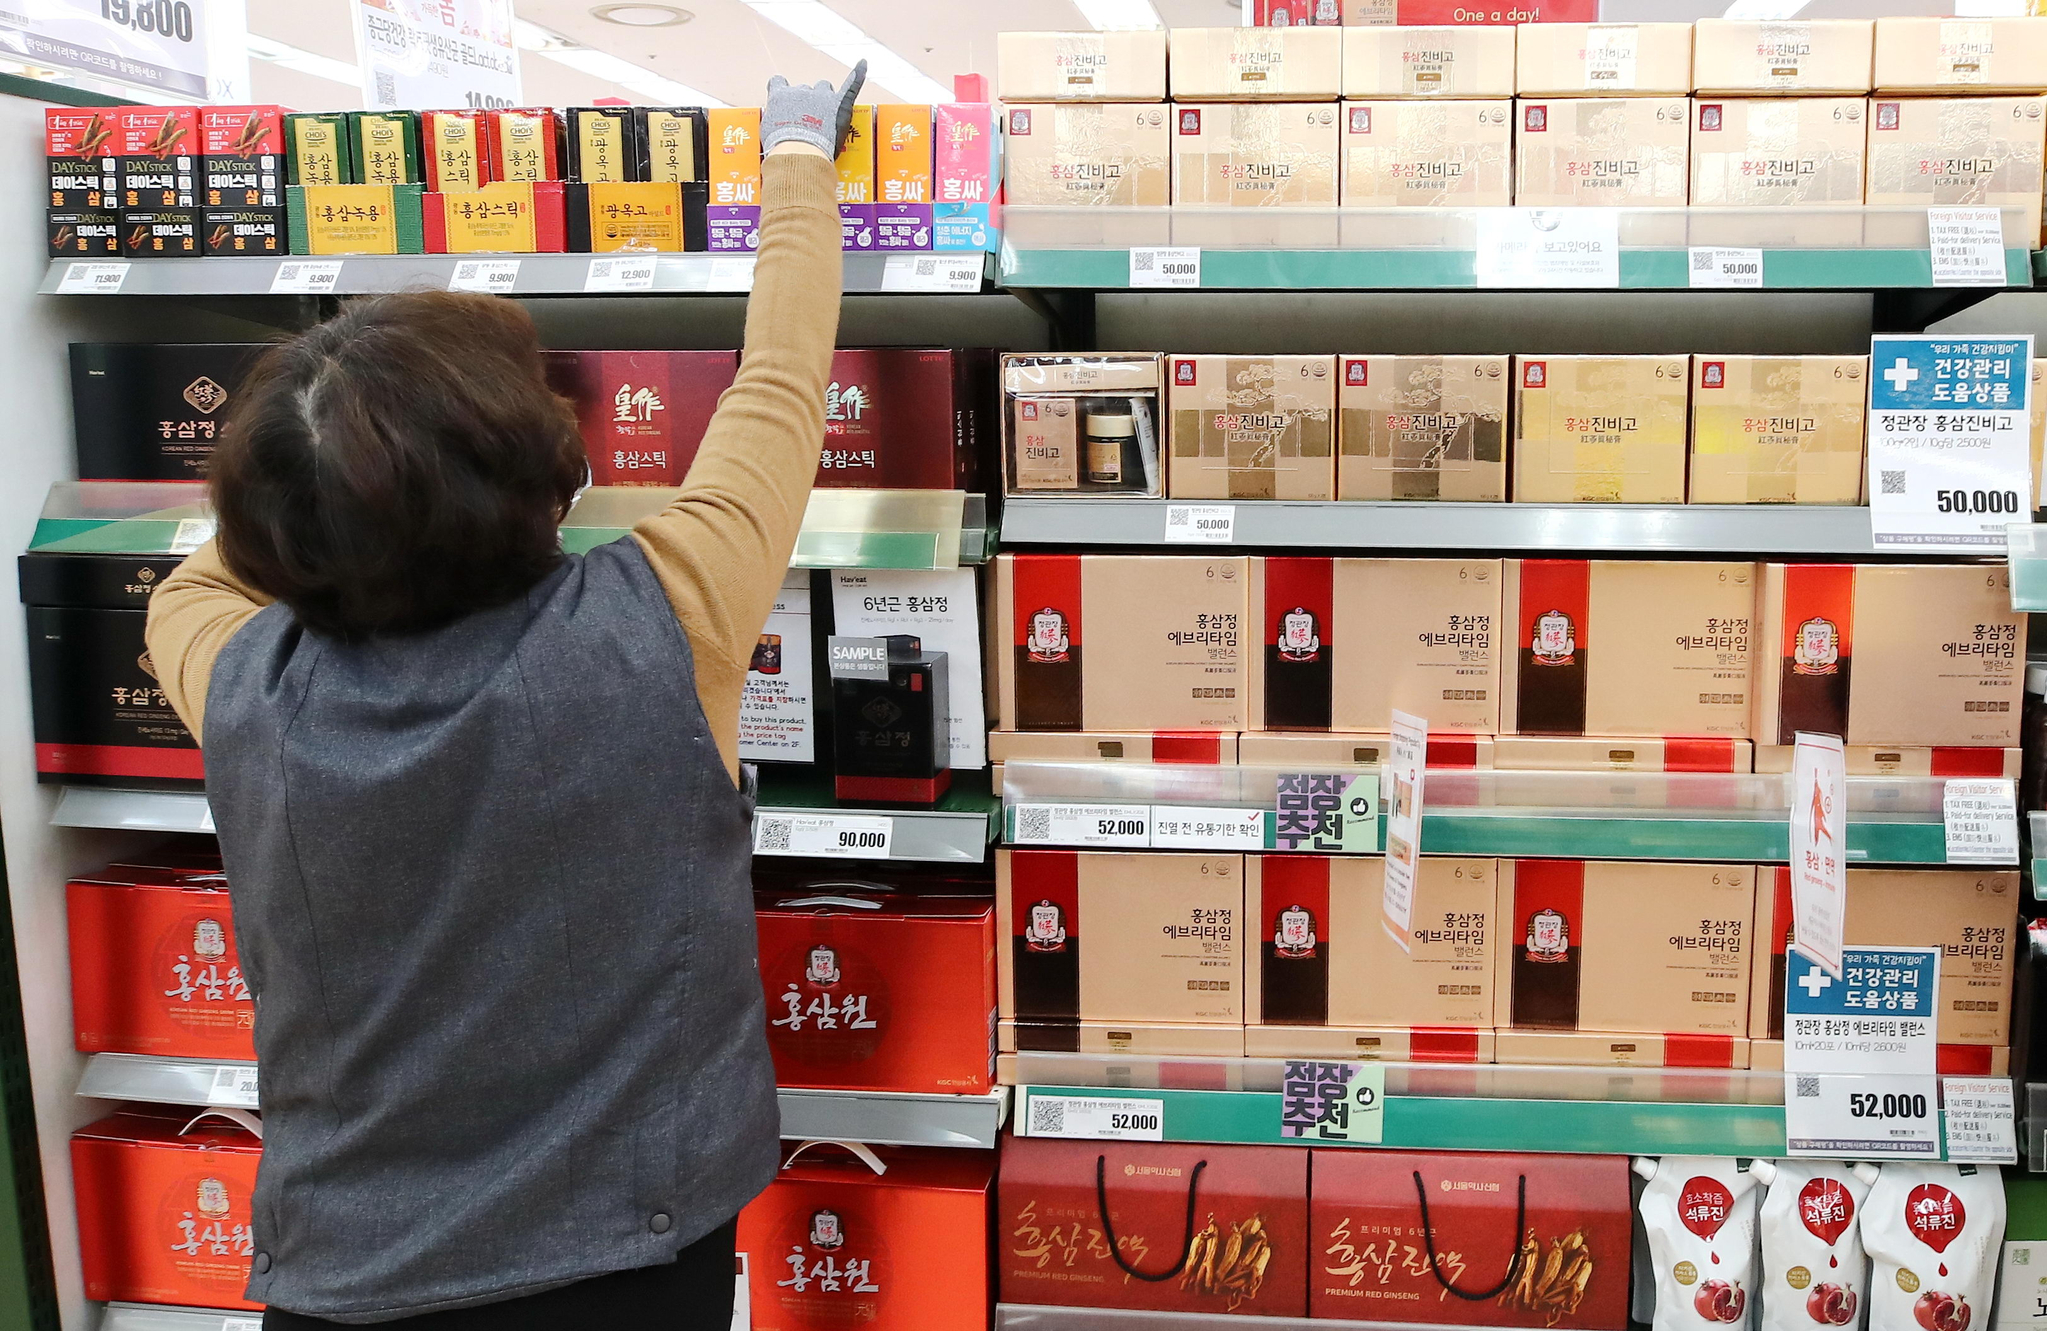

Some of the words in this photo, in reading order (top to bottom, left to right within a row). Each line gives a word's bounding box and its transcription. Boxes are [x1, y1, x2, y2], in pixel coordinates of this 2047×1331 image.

[1454, 8, 1484, 21] One
[1491, 12, 1500, 21] a
[1507, 7, 1540, 23] day!
[1403, 51, 1454, 63] 홍삼진비고
[1757, 44, 1810, 56] 홍삼진비고
[1056, 55, 1107, 66] 홍삼진비고
[1230, 52, 1282, 64] 홍삼진비고
[304, 153, 332, 168] 홍삼
[371, 151, 399, 168] 홍삼
[443, 150, 471, 166] 홍삼
[510, 150, 538, 166] 홍삼
[1051, 164, 1121, 179] 홍삼진비고
[1221, 164, 1290, 179] 홍삼진비고
[1393, 163, 1462, 178] 홍삼진비고
[1566, 160, 1639, 176] 홍삼진비고
[1741, 160, 1815, 176] 홍삼진비고
[1921, 159, 1993, 175] 홍삼진비고
[52, 176, 99, 189] 데이스틱
[126, 175, 173, 188] 데이스틱
[208, 173, 258, 189] 데이스틱
[445, 168, 469, 184] 스틱
[716, 181, 755, 203] 홍싸
[885, 178, 925, 202] 홍싸
[944, 178, 983, 200] 홍싸
[322, 205, 379, 222] 홍삼녹용
[460, 201, 517, 219] 홍삼스틱
[606, 204, 648, 218] 광옥고
[76, 226, 116, 236] 데이스틱
[152, 225, 193, 236] 데이스틱
[234, 224, 275, 235] 데이스틱
[1544, 241, 1602, 253] 보고있어요
[950, 271, 976, 280] 9,900
[1163, 264, 1195, 274] 50,000
[1723, 264, 1757, 274] 50,000
[1953, 344, 1970, 354] 가족
[1935, 359, 2010, 379] 건강관리
[1933, 383, 2010, 403] 도움상품
[158, 421, 215, 438] 홍삼정
[1216, 415, 1284, 430] 홍삼진비고
[1386, 414, 1458, 431] 홍삼진비고
[1567, 417, 1637, 432] 홍삼진비고
[1744, 418, 1815, 433] 홍삼진비고
[1882, 416, 1927, 431] 정관장
[1934, 415, 2012, 432] 홍삼진비고
[1027, 436, 1044, 446] 홍삼
[613, 451, 666, 469] 홍삼스틱
[820, 449, 876, 469] 홍삼스틱
[1025, 447, 1060, 460] 진비고
[1938, 490, 2017, 513] 50,000
[1197, 520, 1229, 529] 50,000
[864, 595, 902, 613] 6년근
[907, 597, 947, 612] 홍삼정
[1196, 614, 1236, 629] 홍삼정
[1448, 615, 1489, 631] 홍삼정
[1706, 618, 1748, 634] 홍삼정
[1168, 632, 1236, 646] 에브리타임
[1973, 624, 2016, 640] 홍삼정
[1419, 633, 1488, 648] 에브리타임
[1676, 636, 1747, 651] 에브리타임
[833, 647, 884, 662] SAMPLE
[1208, 649, 1237, 659] 밸런스
[1459, 650, 1488, 661] 밸런스
[1942, 643, 2014, 658] 에브리타임
[1717, 654, 1747, 664] 밸런스
[1983, 660, 2013, 671] 밸런스
[756, 731, 773, 740] price
[1277, 773, 1346, 811] 점장
[1098, 819, 1144, 837] 52,000
[1157, 821, 1179, 836] 진열
[1181, 821, 1192, 837] 전
[1194, 822, 1236, 838] 유통기한
[1239, 823, 1261, 838] 확인
[1277, 812, 1343, 852] 추천
[839, 832, 885, 847] 90,000
[1191, 909, 1231, 924] 홍삼정
[1444, 913, 1484, 928] 홍삼정
[1163, 926, 1230, 940] 에브리타임
[1699, 920, 1741, 936] 홍삼정
[1962, 927, 2005, 943] 홍삼정
[1415, 930, 1483, 945] 에브리타임
[1669, 936, 1740, 952] 에브리타임
[1203, 943, 1231, 953] 밸런스
[1455, 947, 1483, 957] 밸런스
[1710, 954, 1739, 964] 밸런스
[1864, 955, 1879, 964] 가족
[1972, 962, 2002, 973] 밸런스
[164, 955, 252, 1001] 홍삼원
[1847, 967, 1918, 987] 건강관리
[772, 983, 876, 1031] 홍삼원
[1844, 990, 1918, 1009] 도움상품
[1796, 1020, 1820, 1035] 정관장
[1824, 1020, 1849, 1036] 홍삼정
[1853, 1021, 1896, 1036] 에브리타임
[1899, 1021, 1926, 1037] 밸런스
[1284, 1060, 1353, 1099] 점장
[1851, 1094, 1926, 1119] 52,000
[1111, 1113, 1158, 1131] 52,000
[1282, 1098, 1349, 1141] 추천
[1047, 1208, 1085, 1218] 프리미엄
[1685, 1205, 1725, 1224] 석류진
[1806, 1206, 1846, 1226] 석류진
[1914, 1212, 1956, 1231] 석류진
[171, 1211, 254, 1257] 홍삼원
[1361, 1226, 1401, 1235] 프리미엄
[1324, 1216, 1467, 1302] 홍삼진액
[776, 1245, 879, 1293] 홍삼원
[1014, 1270, 1050, 1278] PREMIUM
[1070, 1274, 1104, 1282] GINSENG
[1326, 1288, 1363, 1296] PREMIUM
[1384, 1292, 1419, 1300] GINSENG
